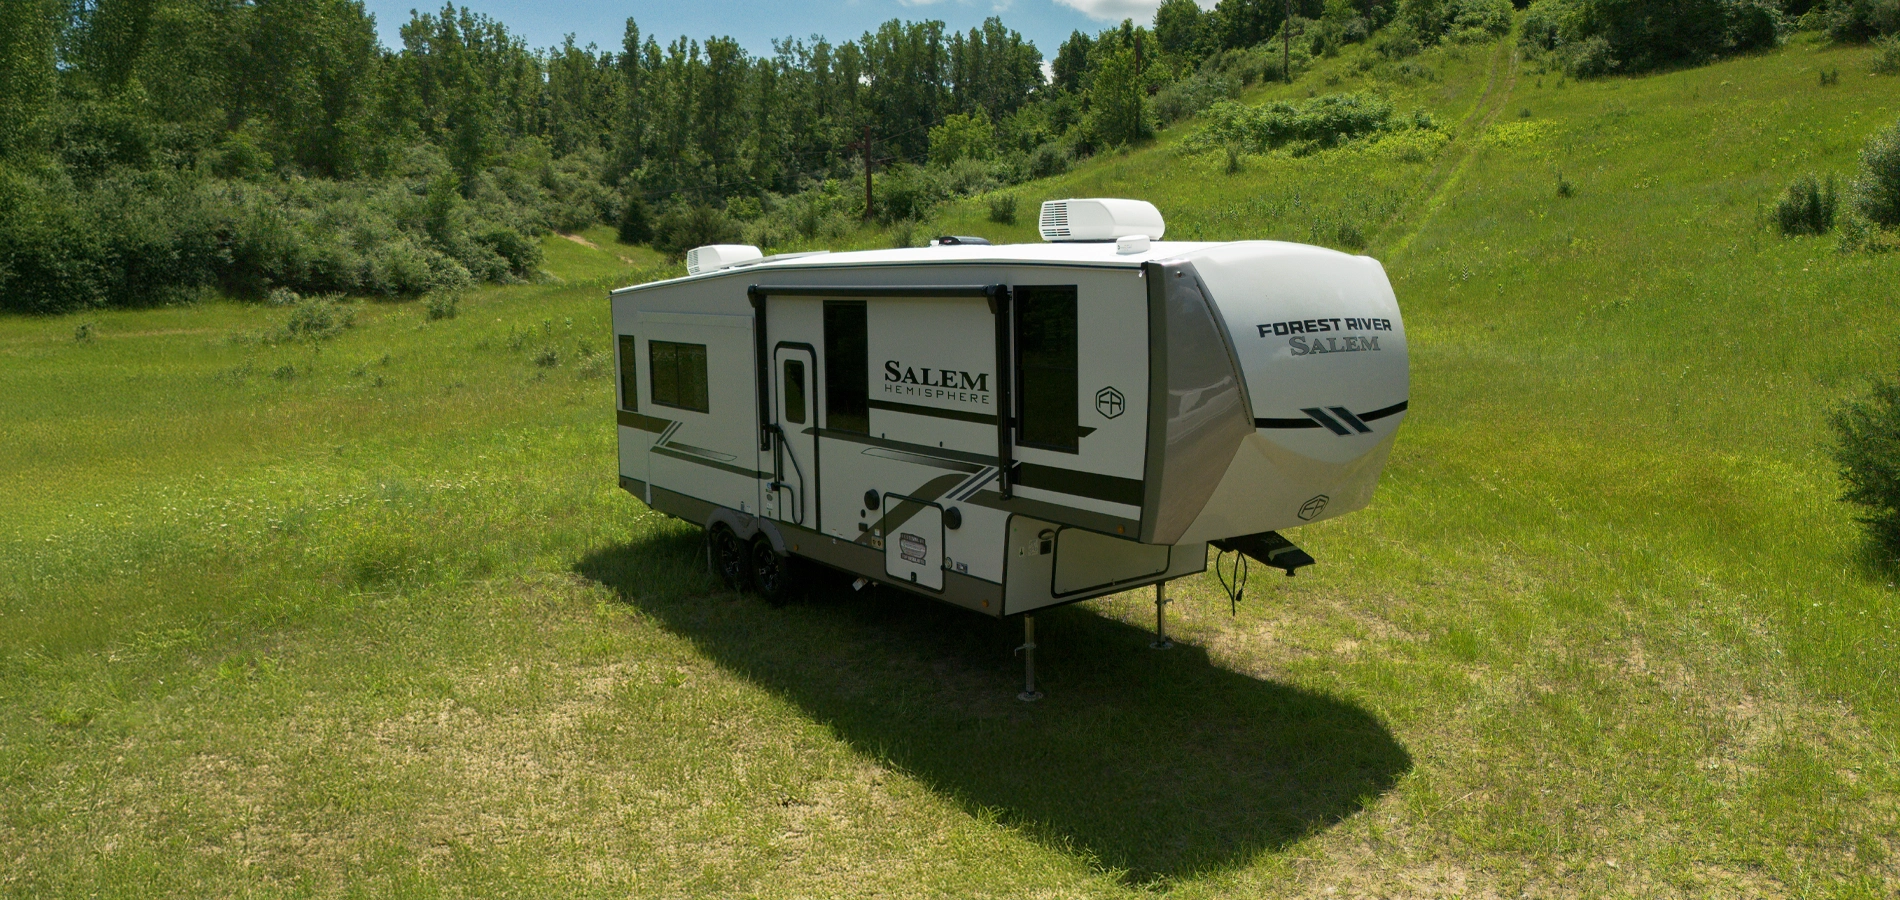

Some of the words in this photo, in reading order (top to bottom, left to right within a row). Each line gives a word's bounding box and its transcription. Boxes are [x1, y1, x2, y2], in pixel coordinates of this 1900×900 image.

[1256, 318, 1341, 338] FOREST
[1344, 317, 1392, 331] RIVER
[1288, 335, 1381, 356] SALEM
[884, 360, 989, 392] SALEM
[884, 384, 989, 404] HEMISPHERE
